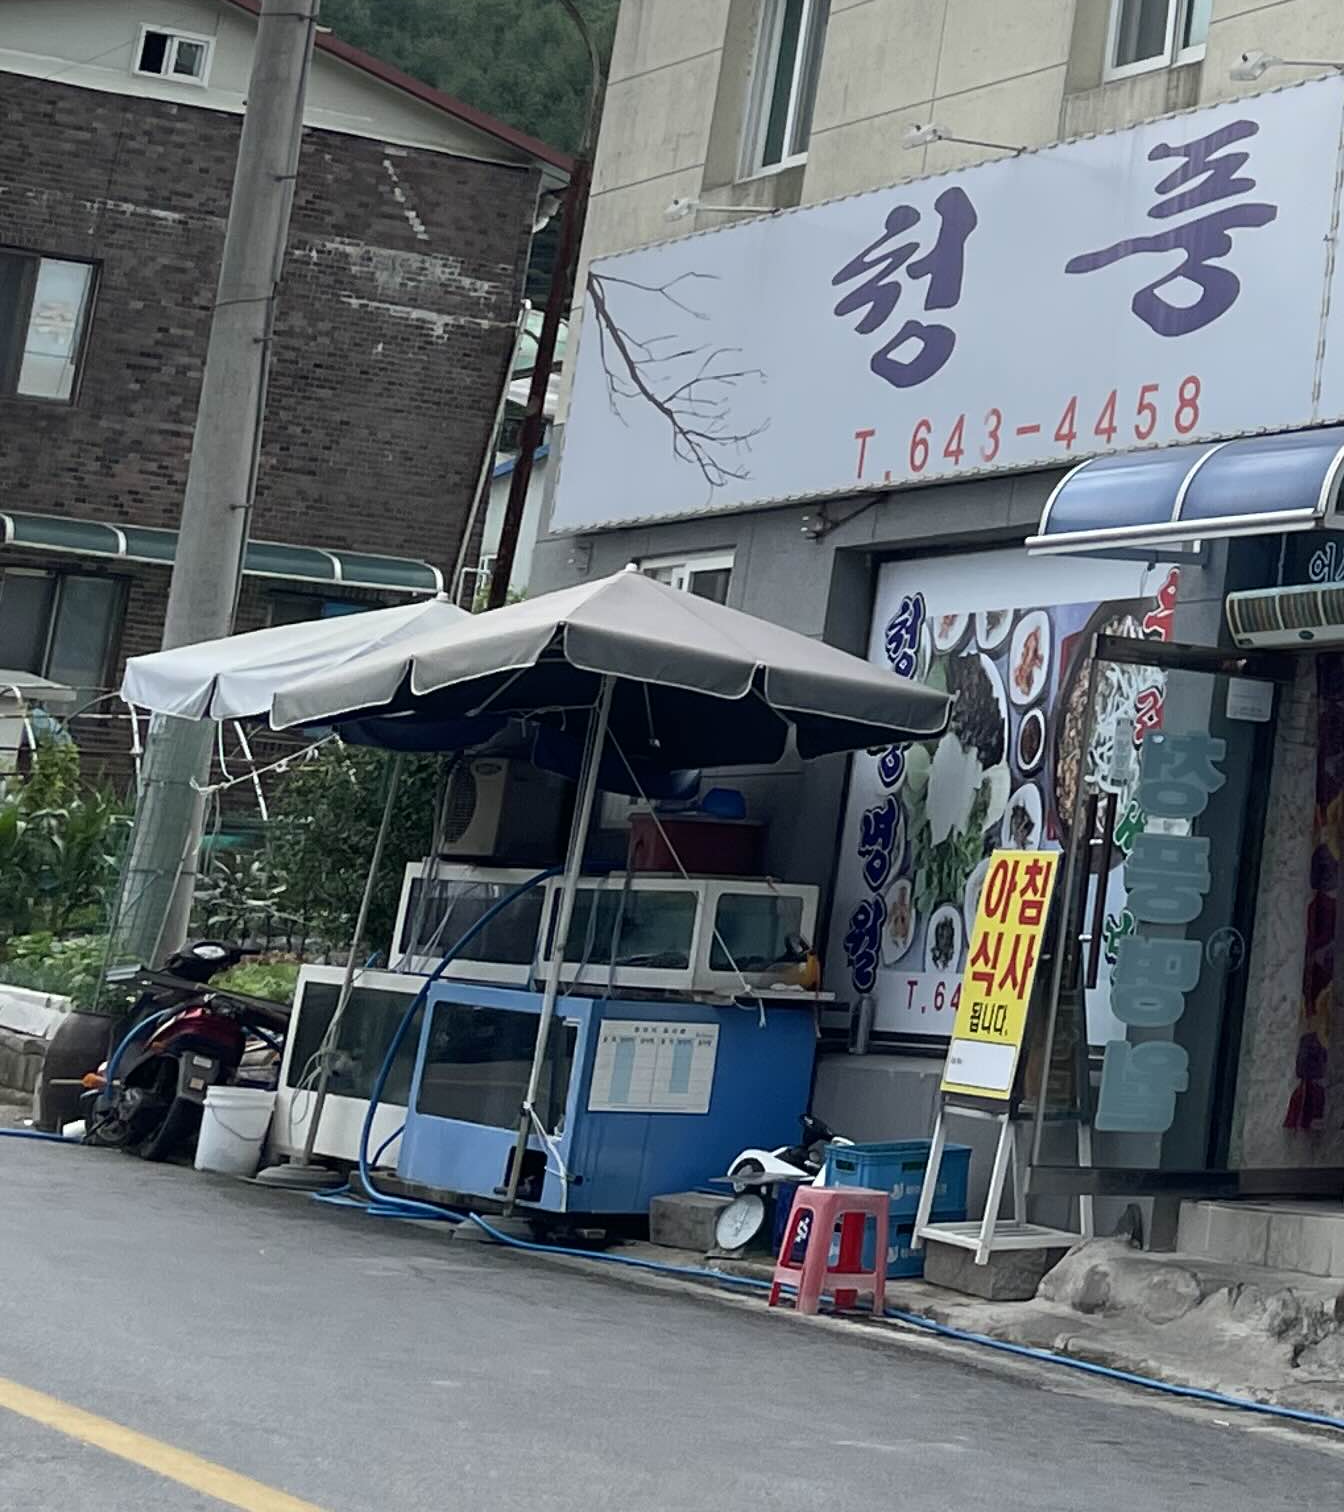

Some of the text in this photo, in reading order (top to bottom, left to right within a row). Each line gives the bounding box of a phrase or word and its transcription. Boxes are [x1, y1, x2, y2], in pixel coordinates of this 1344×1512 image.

[855, 375, 1201, 482] T.643-4458
[983, 858, 1053, 926] 아침
[970, 931, 1037, 1000] 식사
